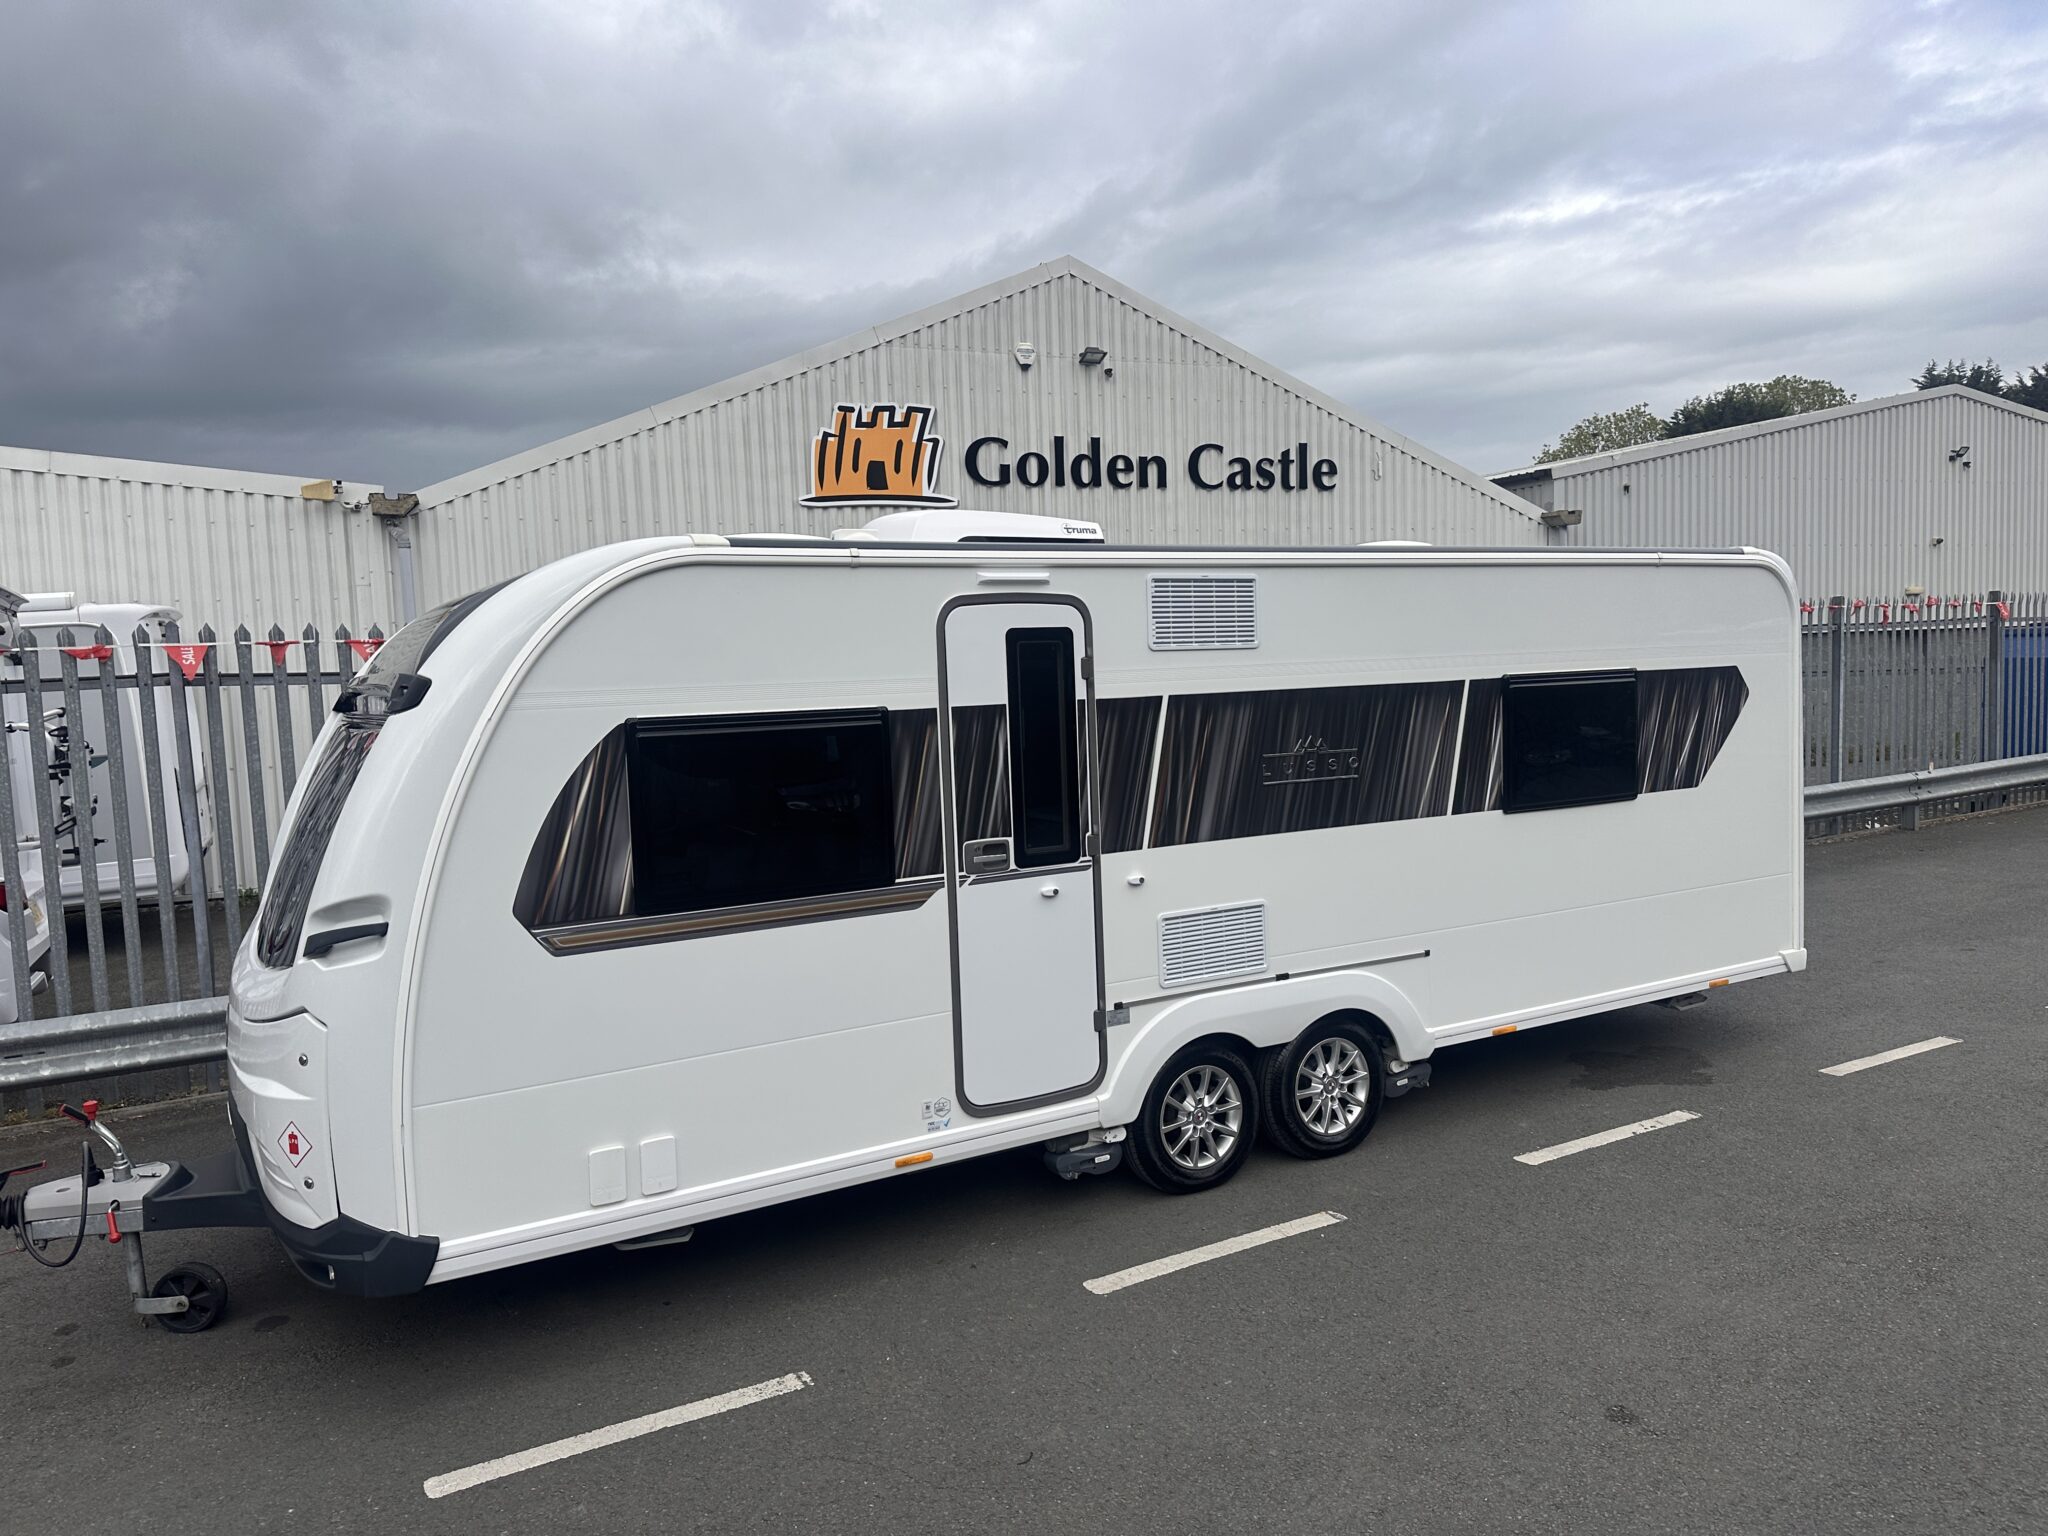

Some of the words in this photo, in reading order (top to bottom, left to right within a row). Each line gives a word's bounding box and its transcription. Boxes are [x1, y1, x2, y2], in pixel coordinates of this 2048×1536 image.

[964, 435, 1168, 489] Golden
[1187, 442, 1338, 492] Castle
[1063, 523, 1097, 534] truma
